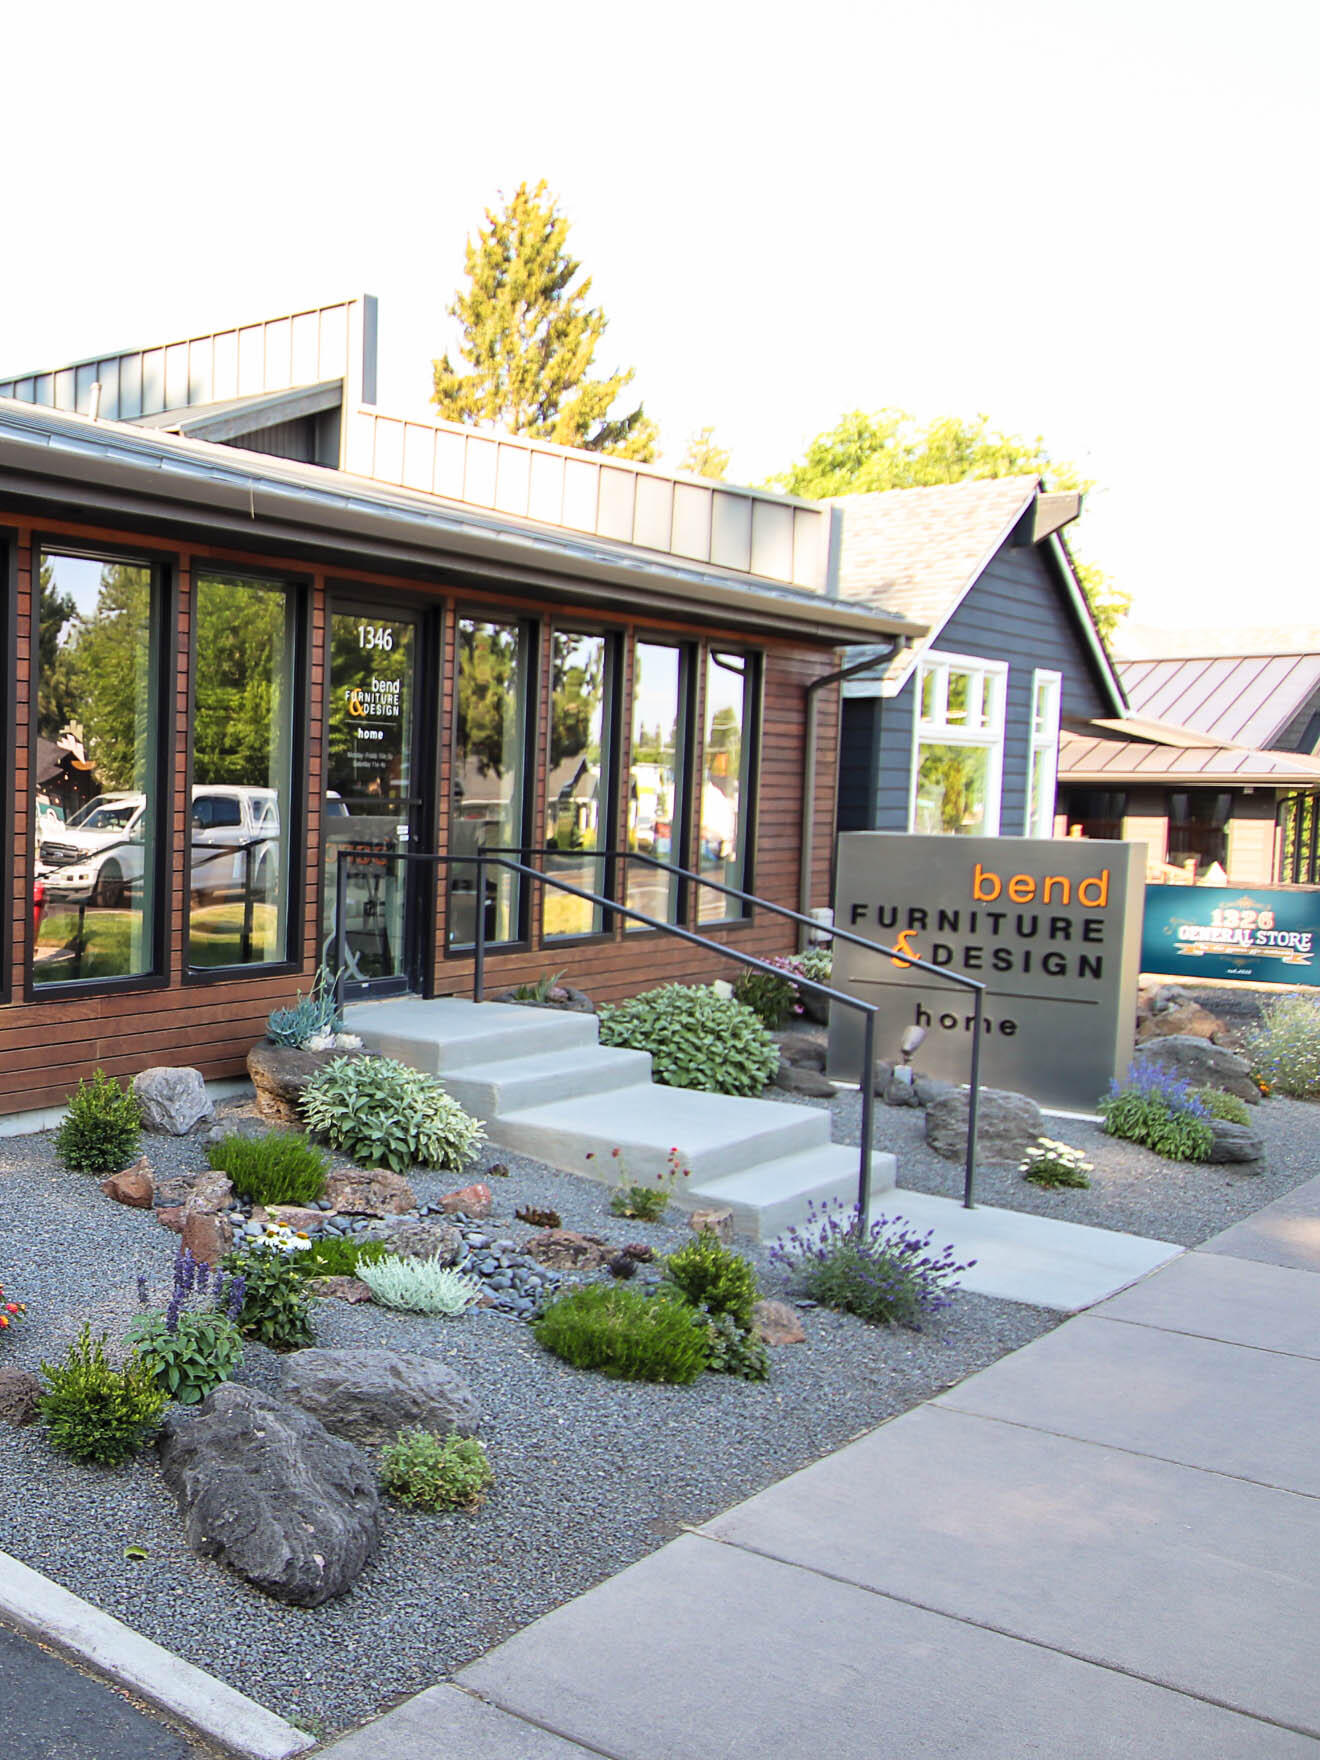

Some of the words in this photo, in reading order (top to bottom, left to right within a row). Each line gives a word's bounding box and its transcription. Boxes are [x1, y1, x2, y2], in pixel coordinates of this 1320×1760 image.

[358, 626, 393, 651] 1346
[345, 690, 399, 705] FURNITURE
[372, 677, 400, 693] bend
[349, 688, 366, 717] &
[363, 703, 399, 716] DESIGN
[357, 728, 384, 740] home
[973, 863, 1110, 907] bend
[851, 903, 1105, 943] FURNITURE
[1211, 909, 1275, 930] 1326
[1179, 926, 1253, 947] GENERAL
[1256, 931, 1313, 952] STORE
[890, 930, 921, 968] &
[932, 943, 1102, 979] DESIGN
[916, 1003, 1018, 1036] home
